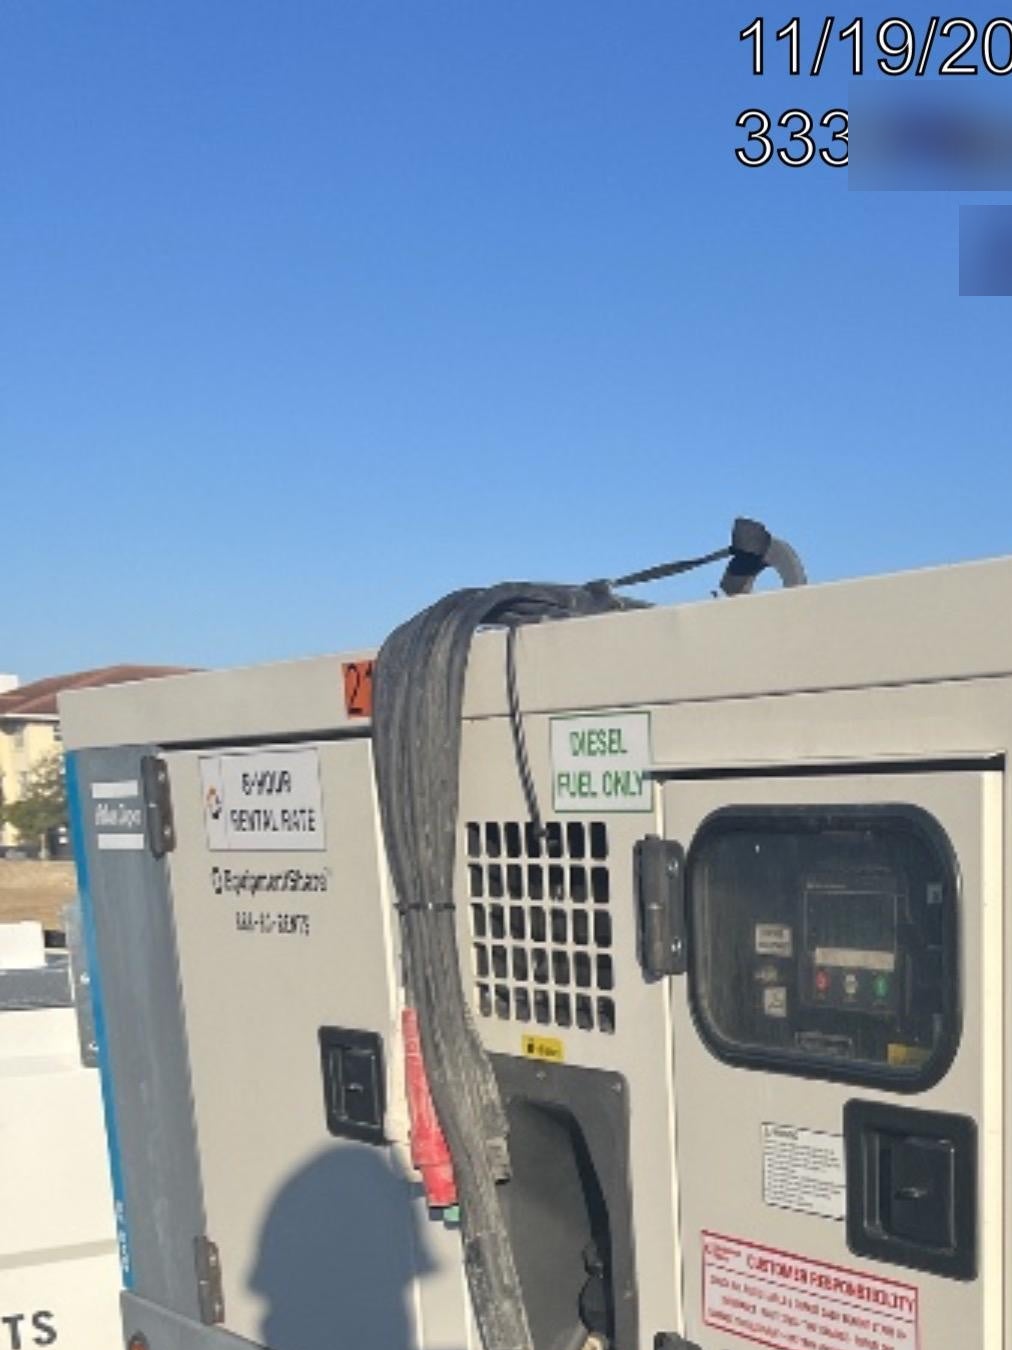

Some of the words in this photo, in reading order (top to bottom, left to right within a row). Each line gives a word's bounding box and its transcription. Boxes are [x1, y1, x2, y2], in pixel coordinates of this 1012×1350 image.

[568, 728, 628, 756] DIESEL
[557, 770, 598, 798] FUEL
[602, 770, 643, 797] ONLY
[229, 808, 280, 833] RENTAL
[281, 807, 317, 832] RATE
